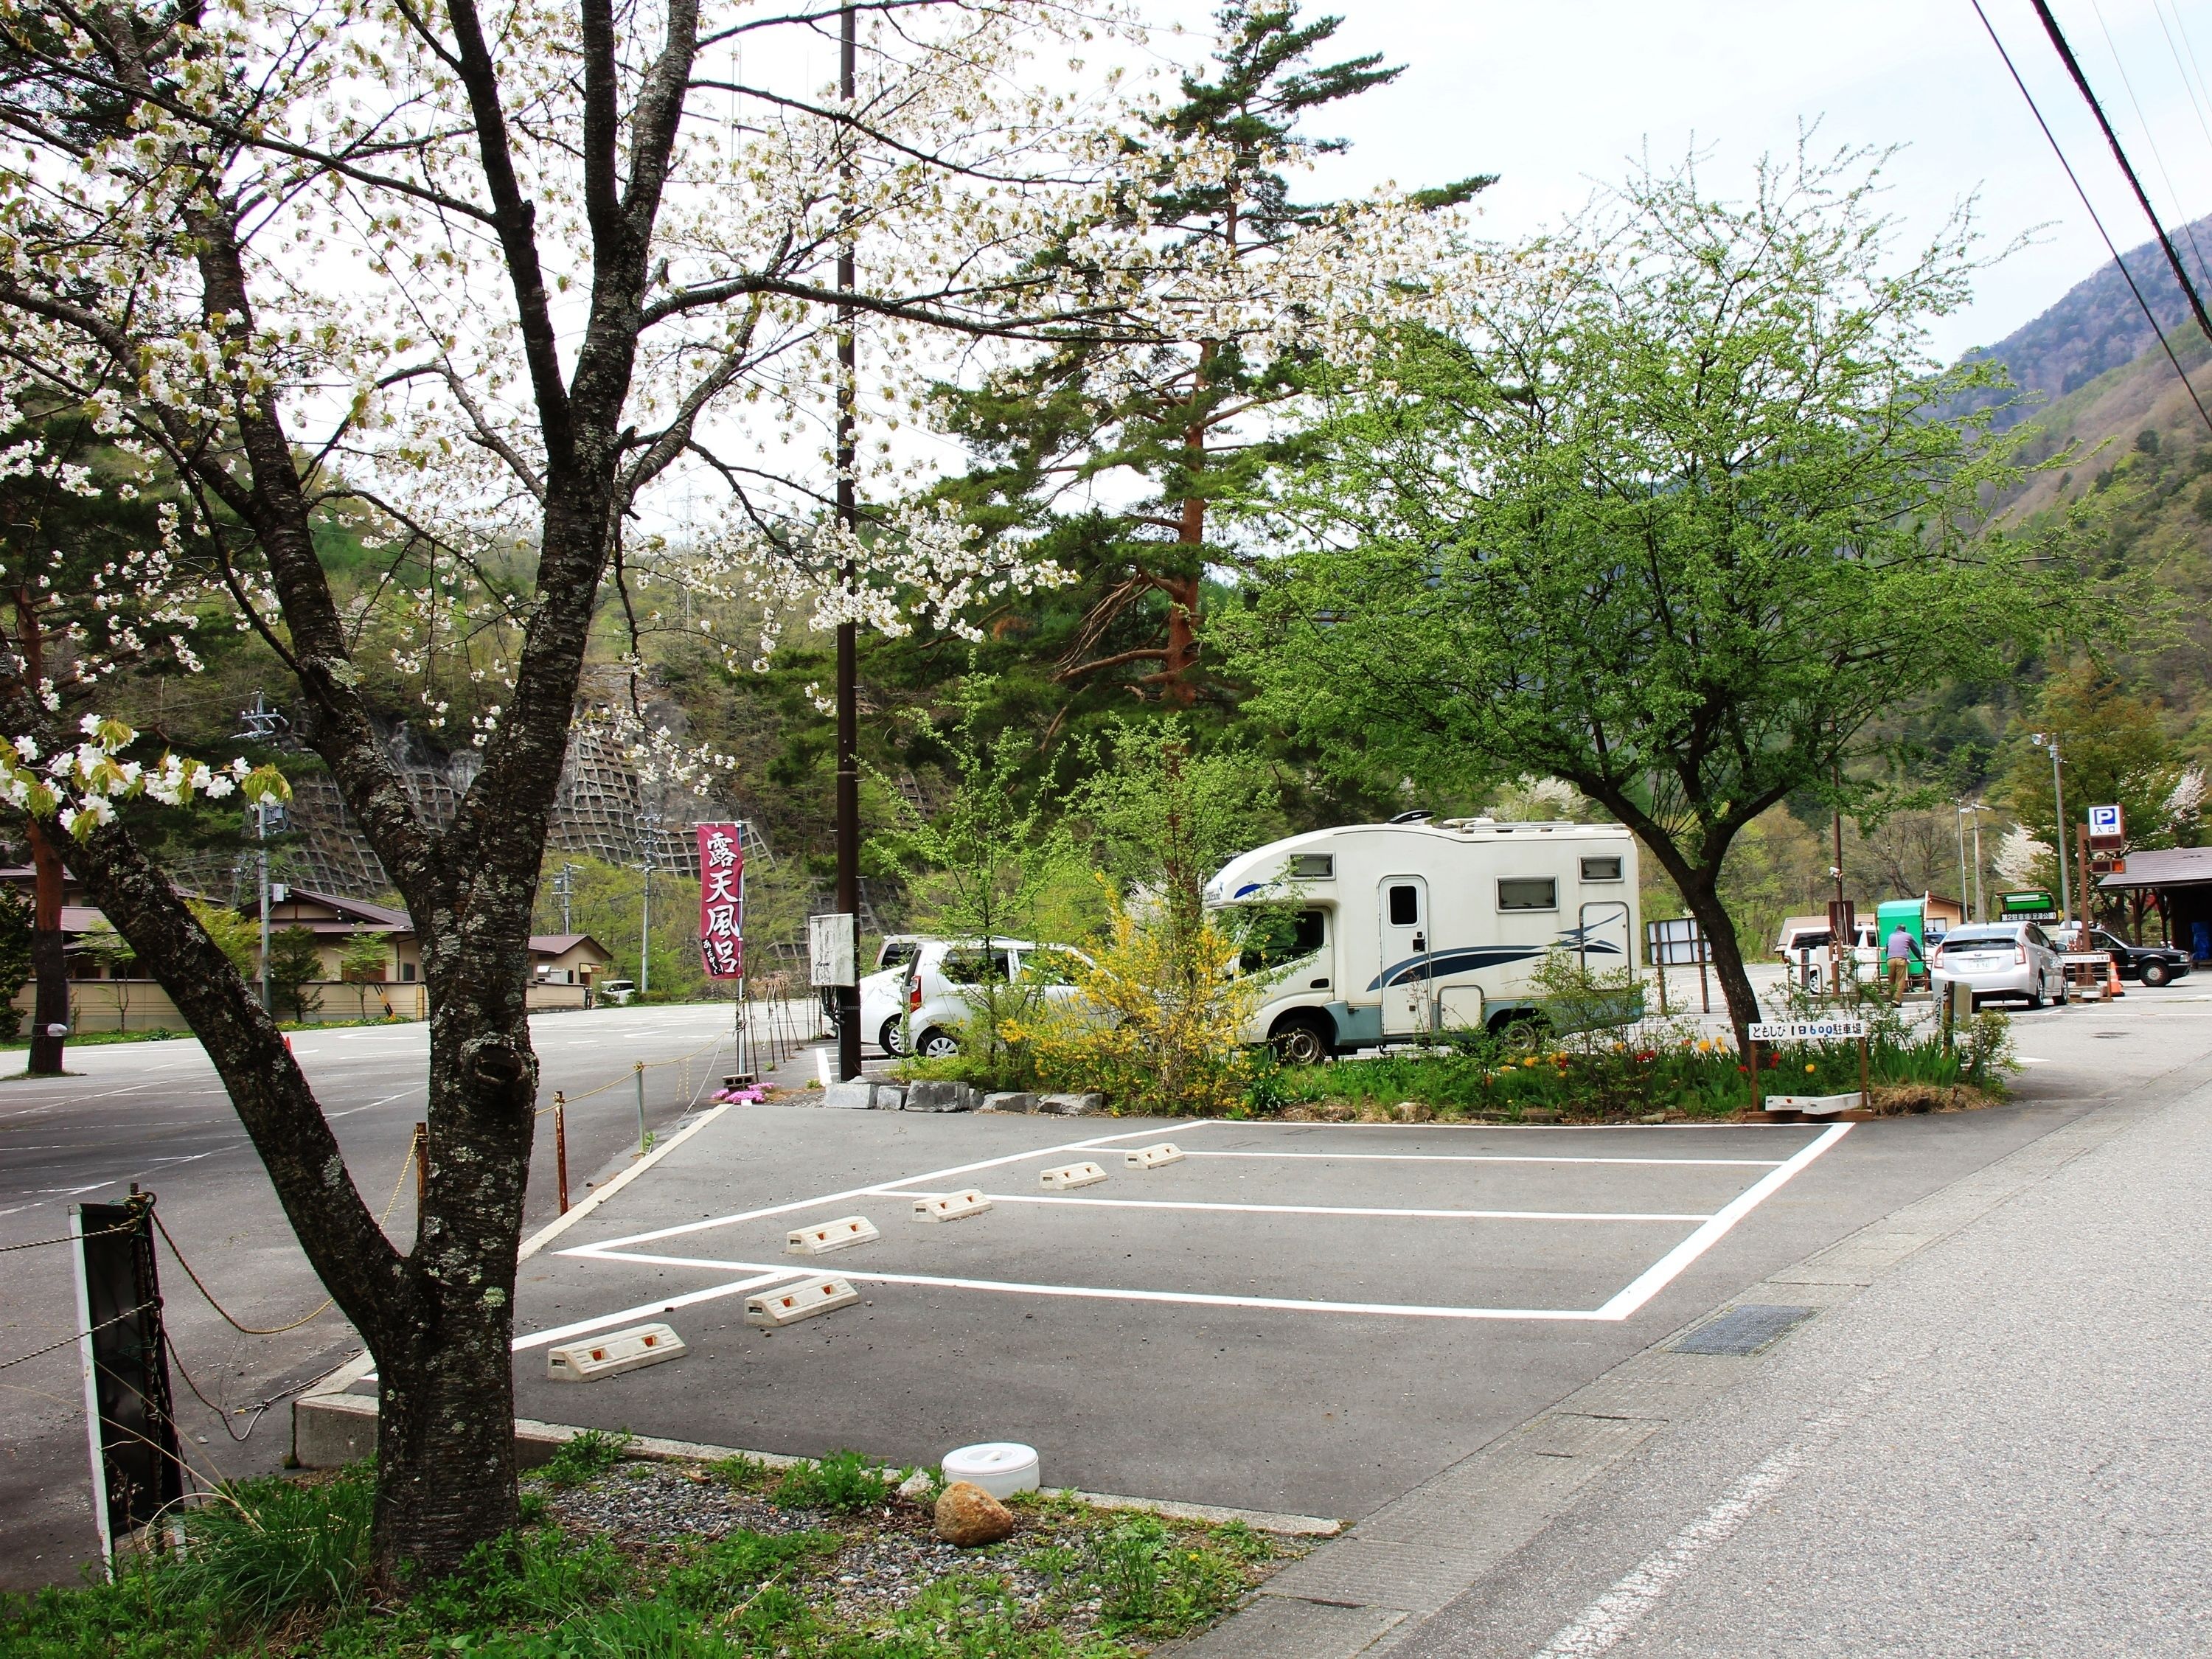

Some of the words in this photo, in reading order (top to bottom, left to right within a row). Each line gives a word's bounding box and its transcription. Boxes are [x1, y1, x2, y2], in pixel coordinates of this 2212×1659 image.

[2096, 810, 2113, 824] P
[706, 832, 740, 974] 露天風呂
[1753, 1025, 1786, 1038] ともしび
